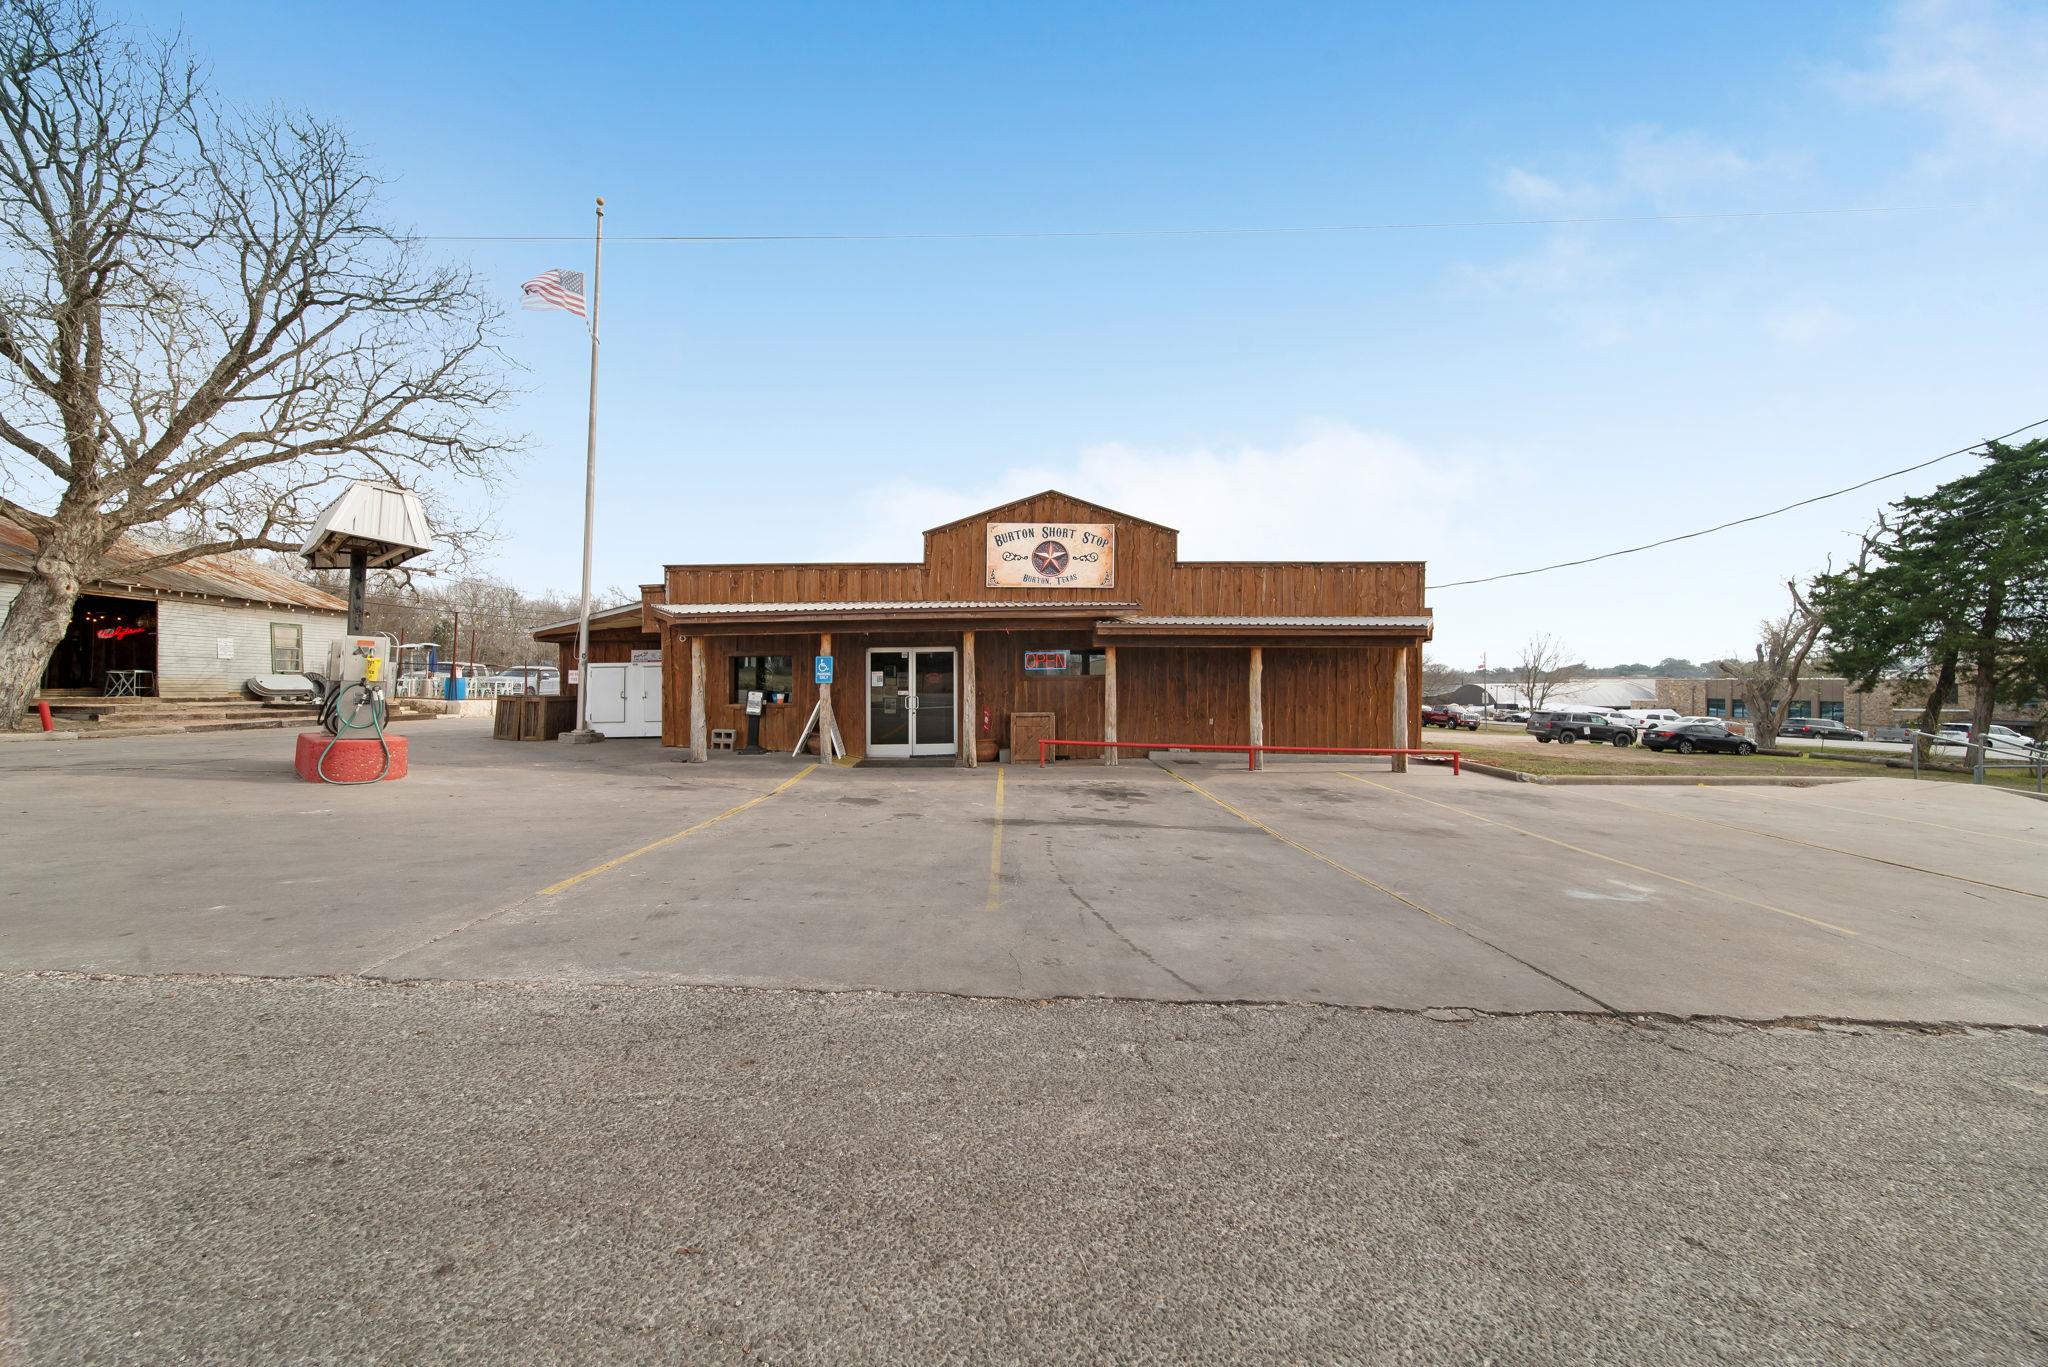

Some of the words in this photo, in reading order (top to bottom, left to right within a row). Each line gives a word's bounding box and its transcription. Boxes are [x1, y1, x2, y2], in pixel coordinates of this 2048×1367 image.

[994, 527, 1035, 547] BURTON
[1041, 526, 1077, 539] SHORT
[1082, 531, 1109, 548] STOP
[1022, 574, 1052, 585] BURTON,
[1056, 573, 1078, 585] TEXAS
[1025, 653, 1066, 669] OPEN
